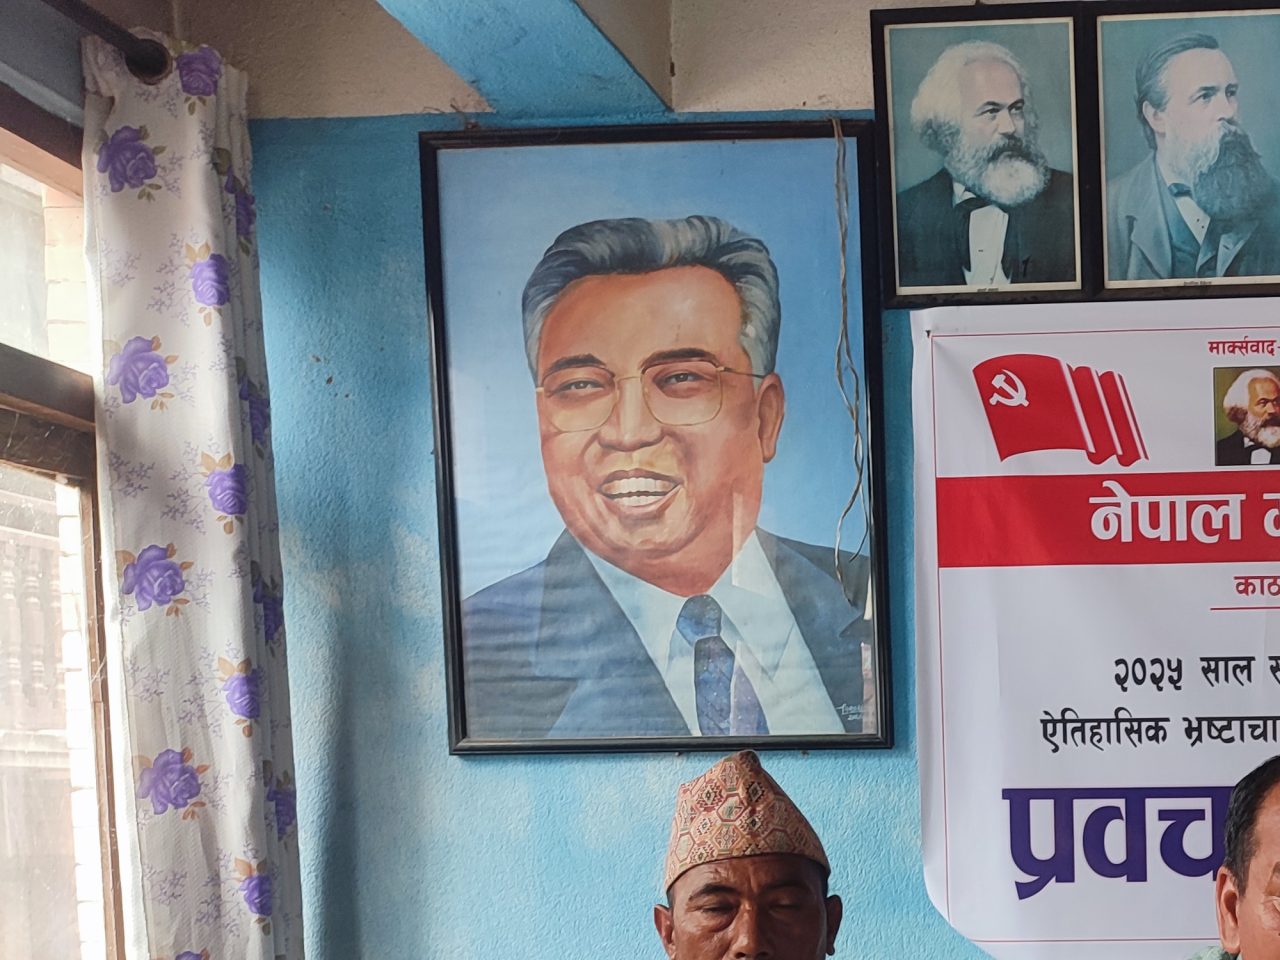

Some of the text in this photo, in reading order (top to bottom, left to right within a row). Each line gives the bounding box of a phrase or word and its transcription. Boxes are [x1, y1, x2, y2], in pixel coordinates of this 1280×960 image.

[1089, 481, 1247, 544] नेपाल
[1114, 656, 1184, 693] २०२५
[1200, 656, 1257, 689] साल
[1040, 707, 1171, 754] ऐतिहासिक
[1001, 785, 1233, 901] प्रवच
